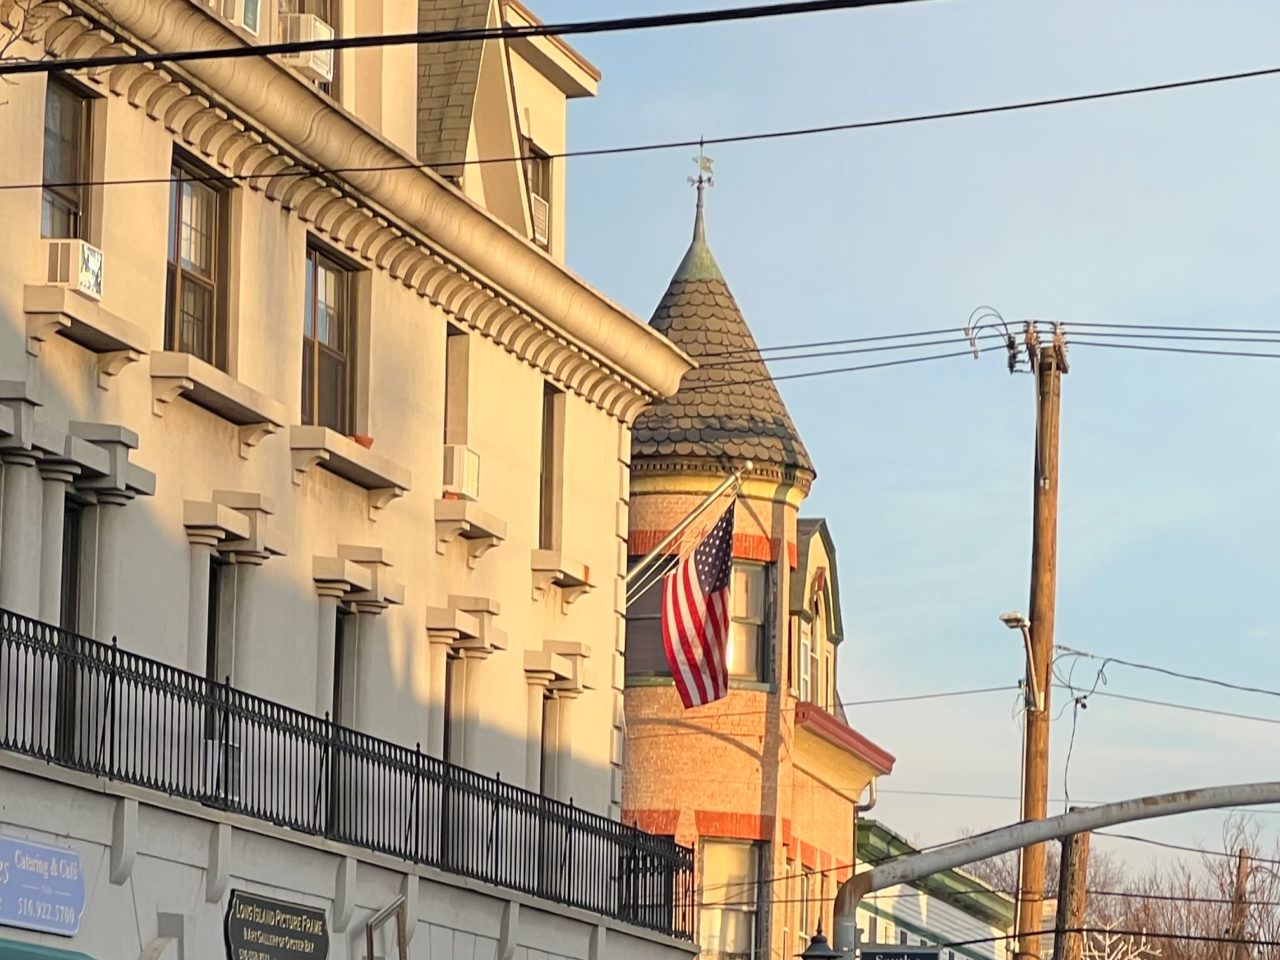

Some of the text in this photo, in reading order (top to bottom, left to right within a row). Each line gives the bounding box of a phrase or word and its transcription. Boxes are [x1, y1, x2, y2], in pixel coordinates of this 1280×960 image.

[15, 850, 49, 879] Catering
[50, 858, 58, 877] &
[275, 909, 302, 931] PICTURE
